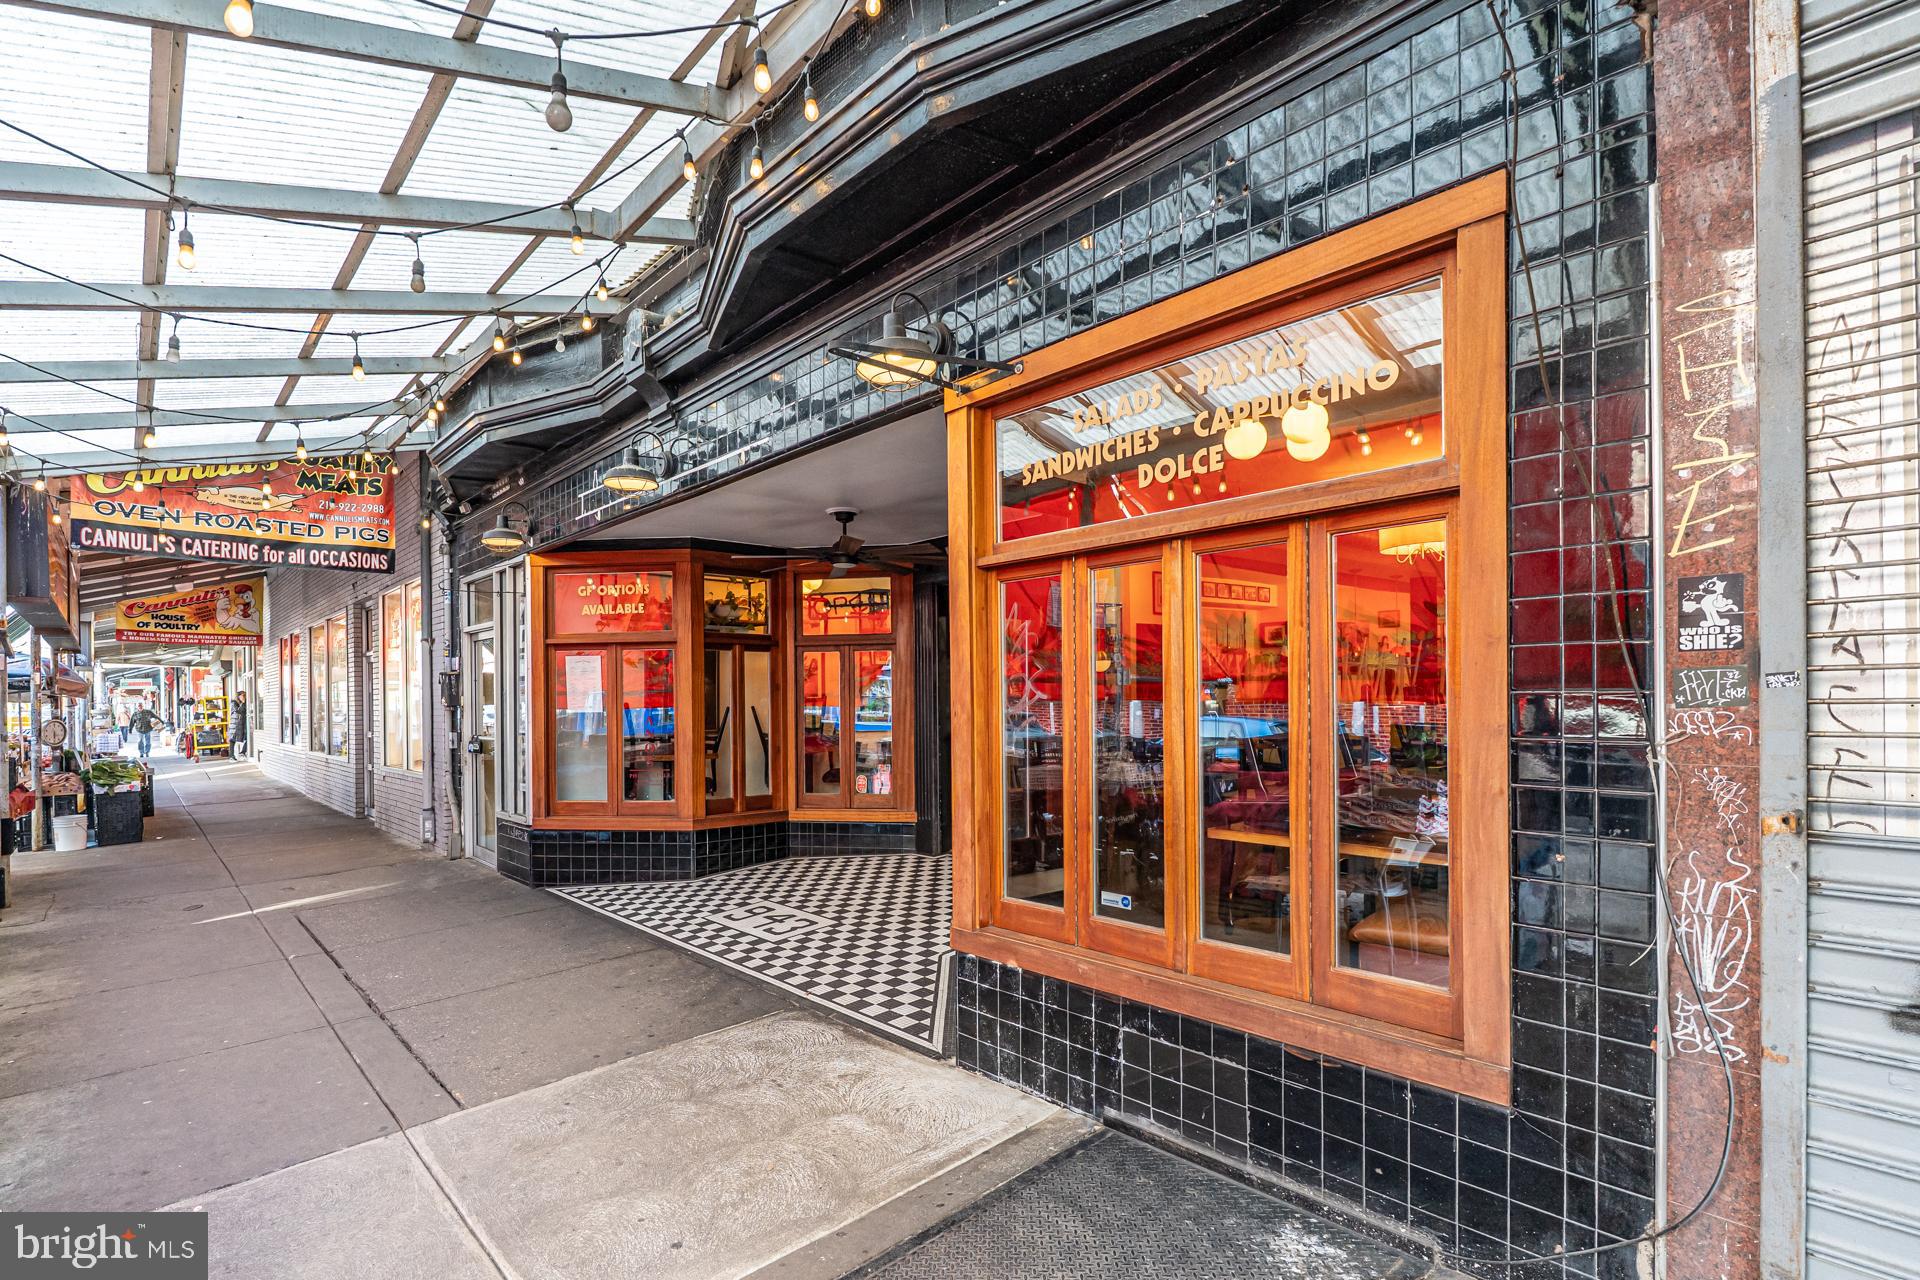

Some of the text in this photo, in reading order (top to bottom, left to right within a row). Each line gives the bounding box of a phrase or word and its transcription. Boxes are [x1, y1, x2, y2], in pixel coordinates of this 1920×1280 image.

[1073, 336, 1311, 434] SALADS PASTAS
[1022, 359, 1400, 487] SANDWICHES CAPPUCCINO
[86, 460, 279, 494] Cannuis
[1138, 444, 1225, 489] DOLCE
[295, 469, 383, 497] MEATS
[319, 500, 385, 514] 21-922-2988
[94, 501, 389, 543] OVEN ROASTED PIGS
[80, 527, 389, 570] CANNULIS CATERING for all OCCASIONS
[578, 584, 650, 597] GF OPTIONS
[151, 613, 186, 622] HOUSE
[581, 603, 645, 616] AVAILABLE
[136, 621, 200, 631] OF POULTRY
[1680, 625, 1742, 635] WHO IS
[1679, 634, 1743, 650] SHIE?
